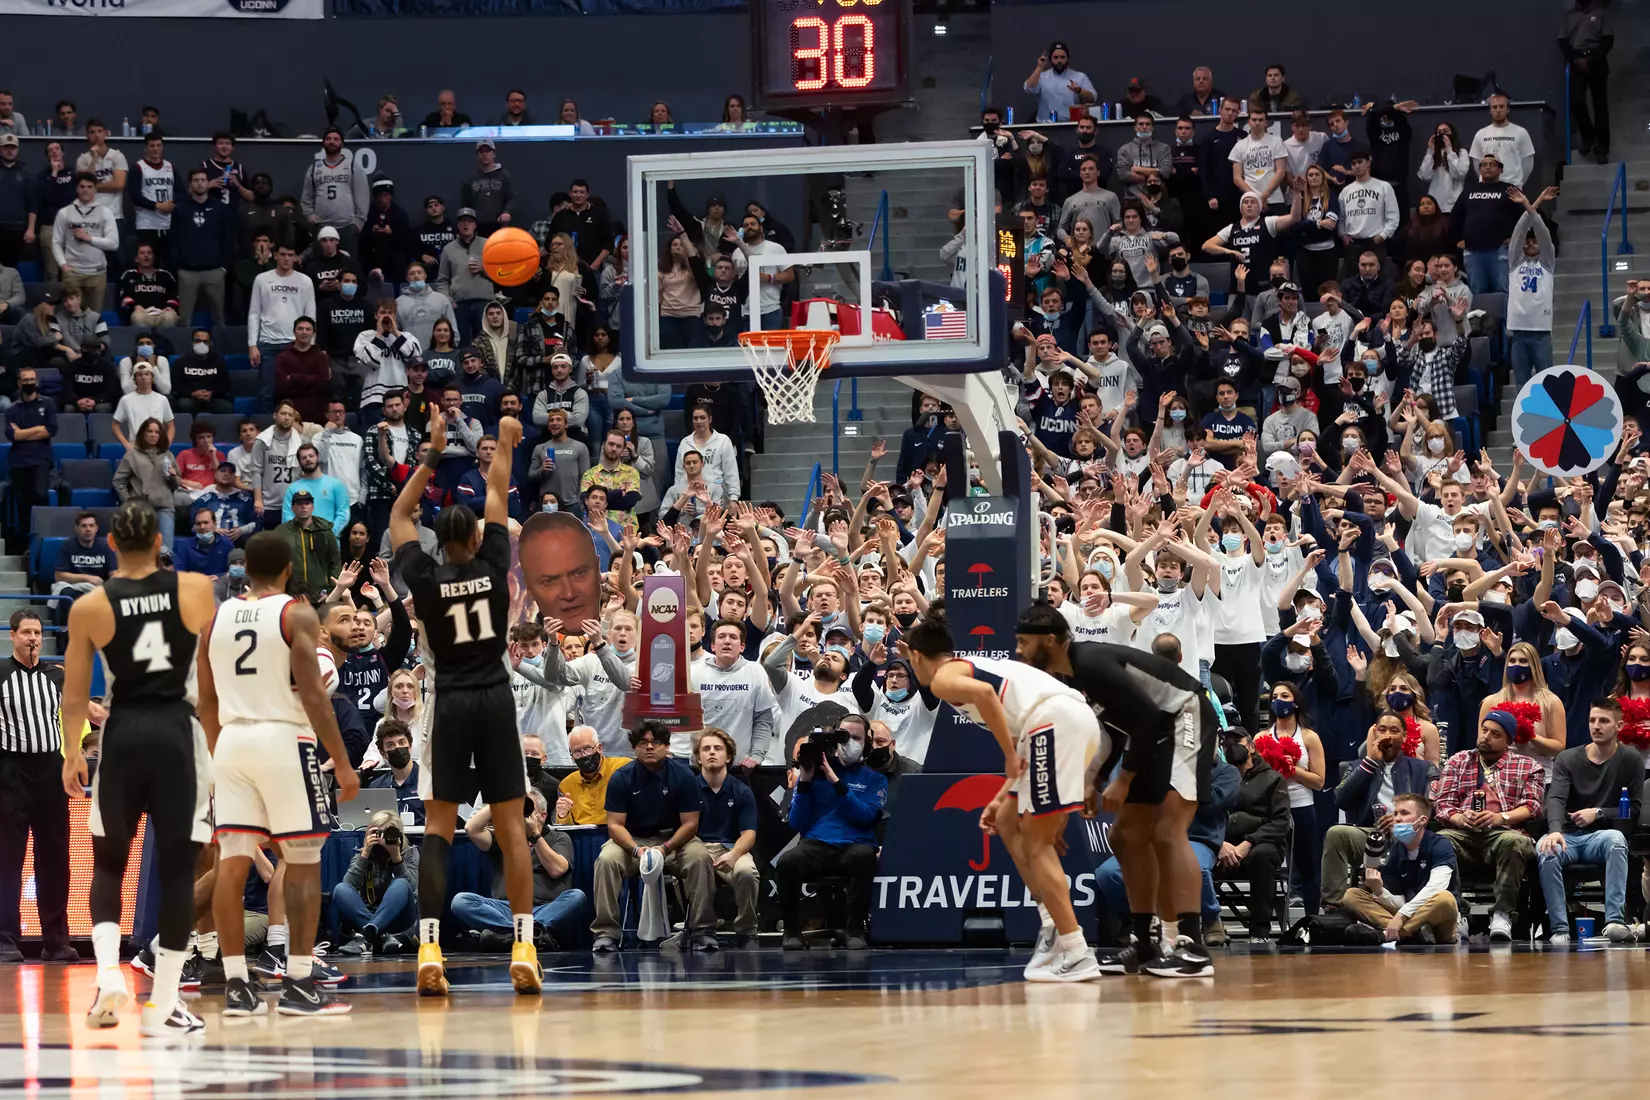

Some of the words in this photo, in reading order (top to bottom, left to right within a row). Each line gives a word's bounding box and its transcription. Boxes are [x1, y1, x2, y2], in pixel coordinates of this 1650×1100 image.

[794, 14, 874, 90] 30
[220, 188, 230, 205] 3
[327, 185, 337, 200] 5
[1346, 188, 1380, 203] UCONN
[1469, 192, 1501, 200] UCONN
[1233, 235, 1260, 245] UCONN
[134, 284, 167, 293] UCONN
[271, 285, 298, 294] UCONN
[1520, 275, 1538, 294] 34
[709, 293, 737, 305] UCONN
[331, 309, 364, 318] UCONN
[75, 374, 103, 383] UCONN
[184, 366, 217, 376] UCONN
[1211, 424, 1243, 434] UCONN
[273, 467, 293, 484] 23
[949, 511, 1014, 527] SPALDING
[71, 555, 106, 565] UCONN
[440, 576, 493, 599] REEVES
[952, 587, 1009, 599] TRAVELERS
[120, 593, 171, 617] BYNUM
[650, 604, 678, 614] NCAA
[235, 608, 261, 624] COLE
[444, 599, 497, 645] 11
[132, 620, 174, 674] 4
[234, 629, 258, 676] 2
[953, 650, 1010, 660] TRAVELERS
[700, 683, 714, 691] BEAT
[715, 683, 749, 691] PROVIDENCE
[357, 687, 371, 710] 2
[1183, 711, 1195, 751] FRIARS
[1035, 734, 1051, 806] HUSKIES
[306, 747, 330, 826] HUSKIES
